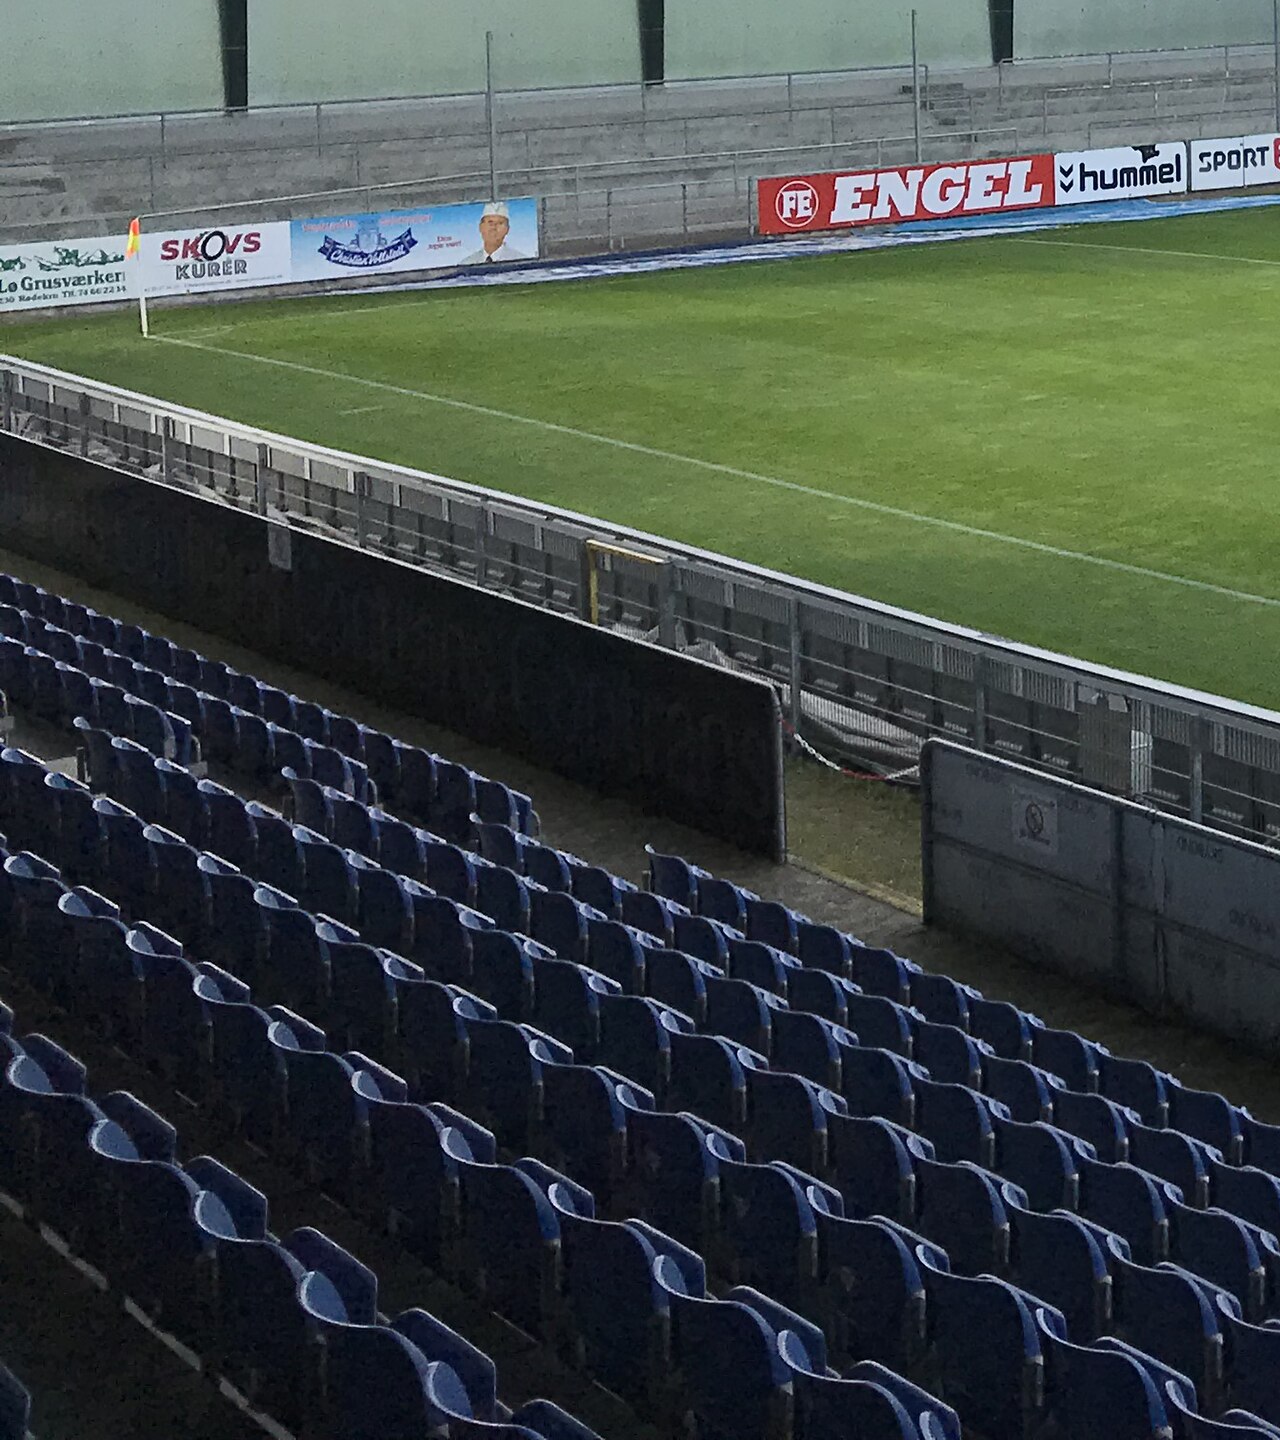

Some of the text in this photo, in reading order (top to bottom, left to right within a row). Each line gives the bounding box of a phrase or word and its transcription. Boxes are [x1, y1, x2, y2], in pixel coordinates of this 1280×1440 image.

[1079, 153, 1182, 192] hummel
[1198, 146, 1271, 173] SPORT
[781, 189, 814, 220] FE
[830, 160, 1044, 225] ENGEL
[160, 230, 261, 262] SKOVS
[20, 269, 122, 292] Grusværker
